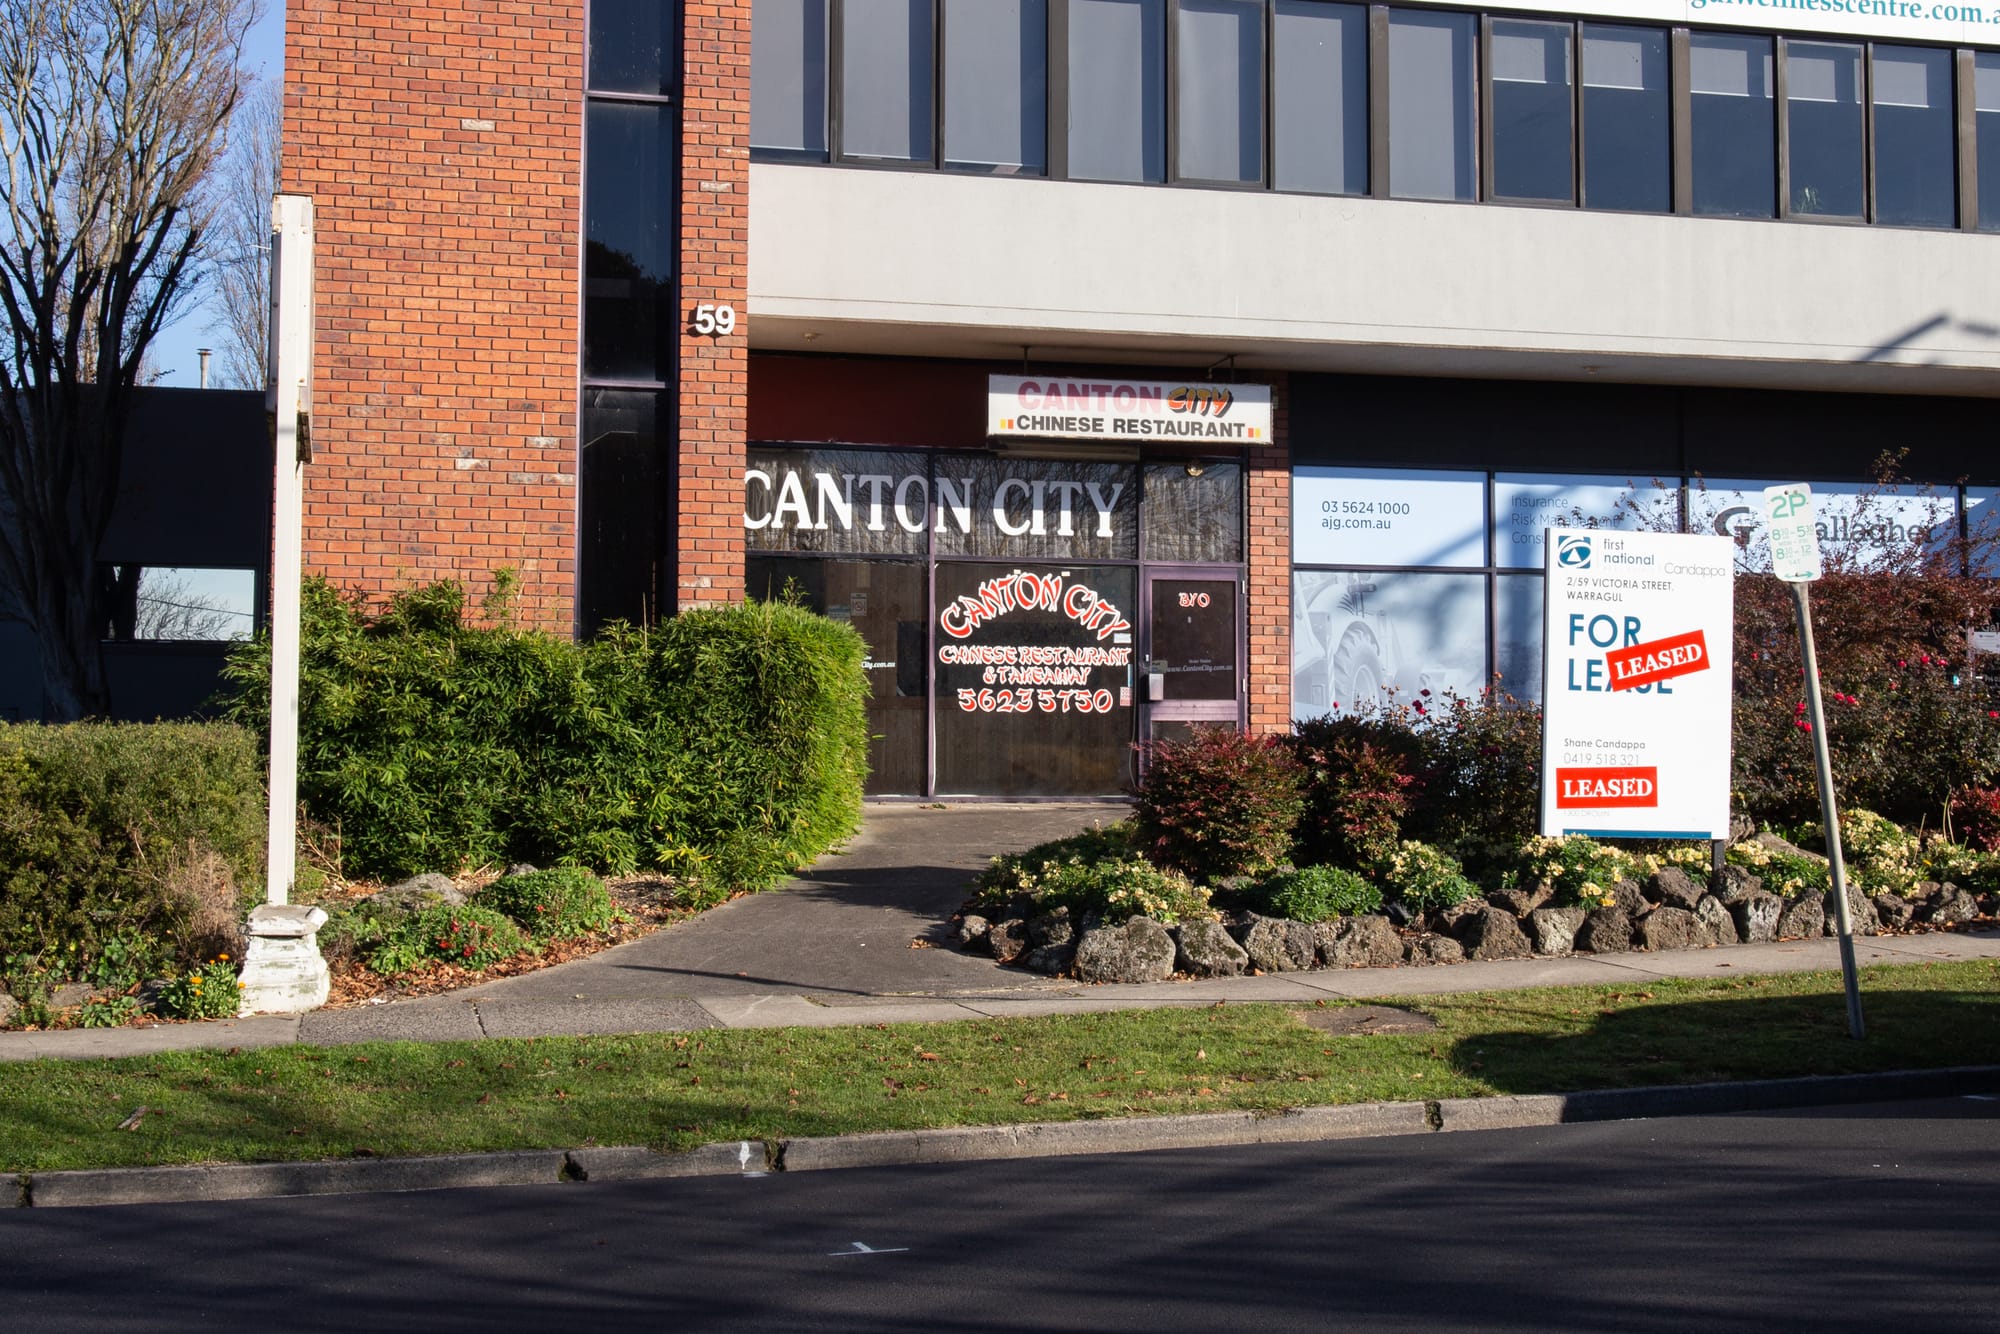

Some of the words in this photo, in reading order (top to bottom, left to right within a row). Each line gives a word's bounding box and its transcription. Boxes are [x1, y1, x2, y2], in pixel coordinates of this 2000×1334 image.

[695, 304, 735, 335] 59
[1017, 381, 1161, 414] CANTON
[1167, 387, 1234, 418] CITY
[1016, 415, 1104, 433] CHINESE
[1113, 418, 1246, 438] RESTAURANT
[743, 469, 973, 534] CANTON
[992, 478, 1124, 538] CITY
[1321, 500, 1339, 514] 03
[1342, 501, 1375, 514] 5624
[1378, 502, 1411, 515] 1000
[1511, 495, 1569, 508] Insurance
[1770, 492, 1807, 519] 2P
[1321, 516, 1392, 530] ajg.com.au
[1511, 512, 1537, 526] Risk
[1603, 538, 1625, 551] first
[1603, 553, 1655, 566] national
[1664, 562, 1726, 577] Candappa
[1567, 577, 1589, 587] 2/59
[1592, 578, 1639, 590] VICTORIA
[1178, 592, 1211, 608] BYO
[1567, 591, 1623, 602] WARRAGUL
[940, 572, 1062, 639] CANTON
[1063, 584, 1131, 640] CITY
[1569, 614, 1642, 648] FOR
[939, 645, 1017, 665] CHINESE
[1019, 646, 1132, 666] RESTAURANT
[1615, 643, 1703, 680] LEASED
[983, 667, 996, 685] &
[998, 666, 1091, 686] TAKEAWAY
[957, 688, 1034, 713] 5623
[1038, 688, 1114, 714] 5750
[1564, 738, 1593, 748] Shane
[1595, 739, 1646, 750] Candappa
[1563, 752, 1592, 765] 0419
[1596, 753, 1617, 766] 518
[1620, 754, 1640, 766] 321
[1563, 778, 1653, 798] LEASED
